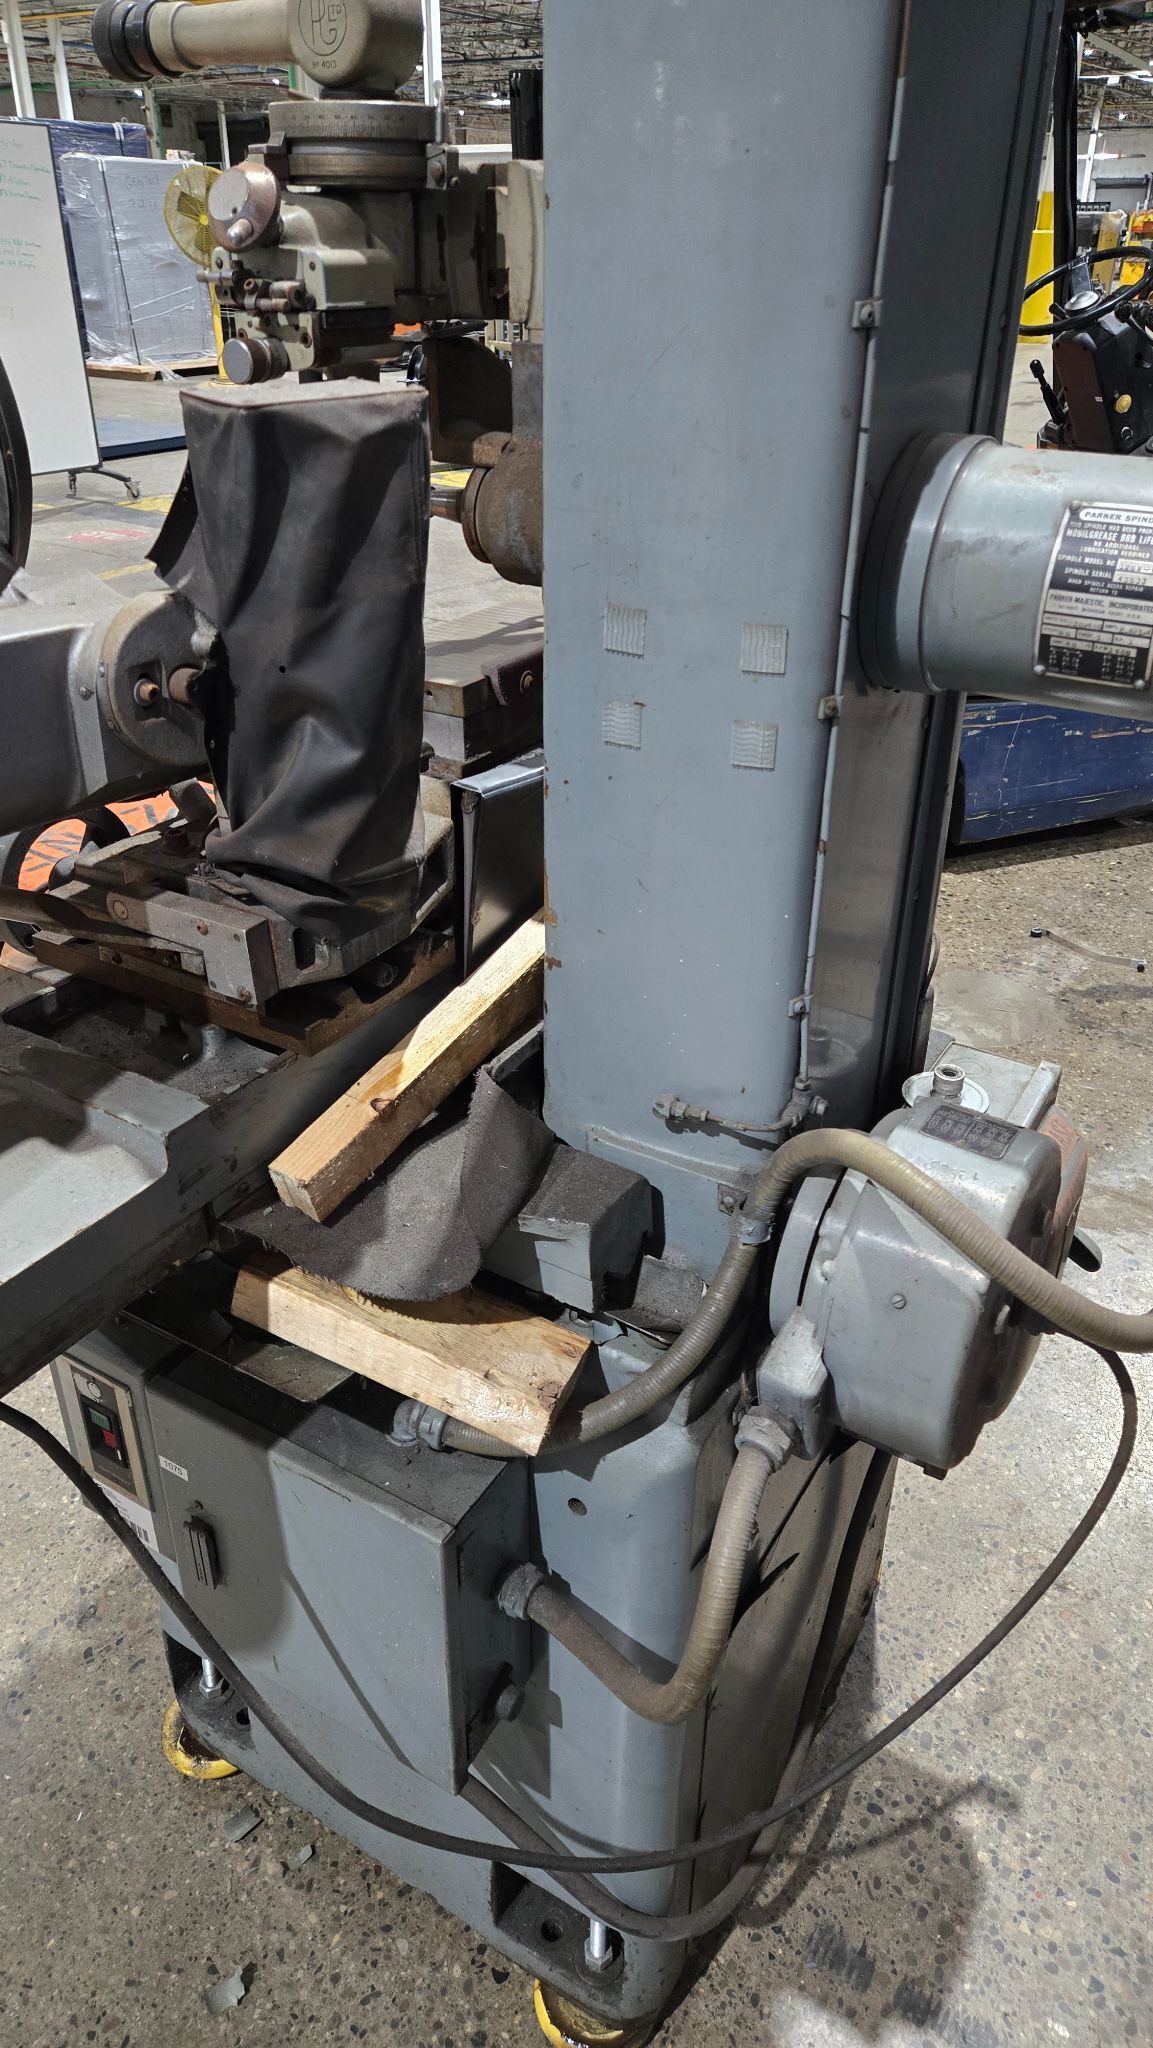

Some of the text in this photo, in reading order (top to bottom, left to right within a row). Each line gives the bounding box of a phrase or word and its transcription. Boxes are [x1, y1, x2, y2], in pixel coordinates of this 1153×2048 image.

[321, 59, 337, 69] 4013
[1084, 511, 1122, 520] PARKER
[1083, 522, 1106, 530] SPINDLE
[1066, 528, 1119, 541] MOBILGREASE
[1119, 533, 1137, 543] BRB
[1104, 541, 1139, 551] ADDITIONAL
[1080, 546, 1150, 559] LUBRICATION REQUIRED
[1058, 554, 1083, 563] SPINDLE
[1084, 556, 1104, 565] MODEL
[1064, 566, 1112, 579] SPINDLE SERIAL
[1074, 596, 1105, 606] MAJESTIC
[164, 1460, 183, 1476] 1075
